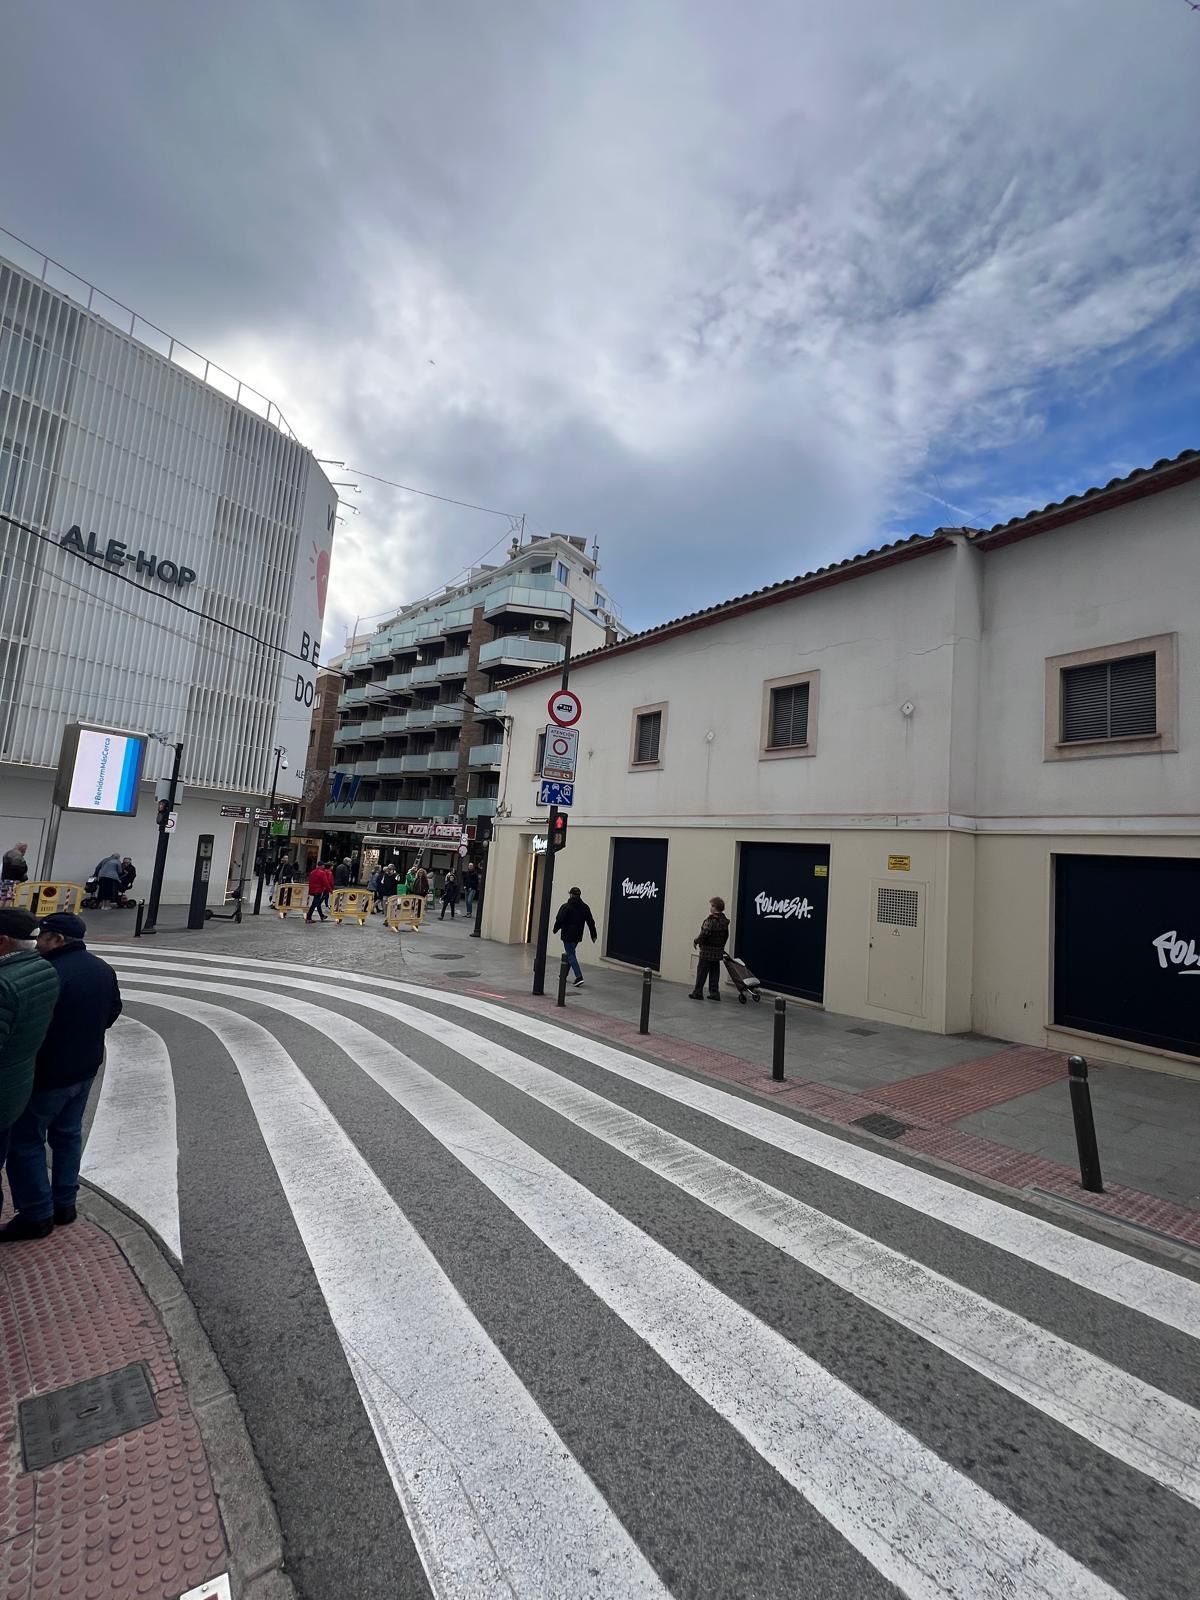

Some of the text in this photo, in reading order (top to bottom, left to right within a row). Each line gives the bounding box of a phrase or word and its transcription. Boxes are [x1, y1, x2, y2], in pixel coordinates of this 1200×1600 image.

[60, 525, 196, 587] ALE-HOP
[295, 673, 314, 707] DO
[1152, 930, 1200, 969] POL
